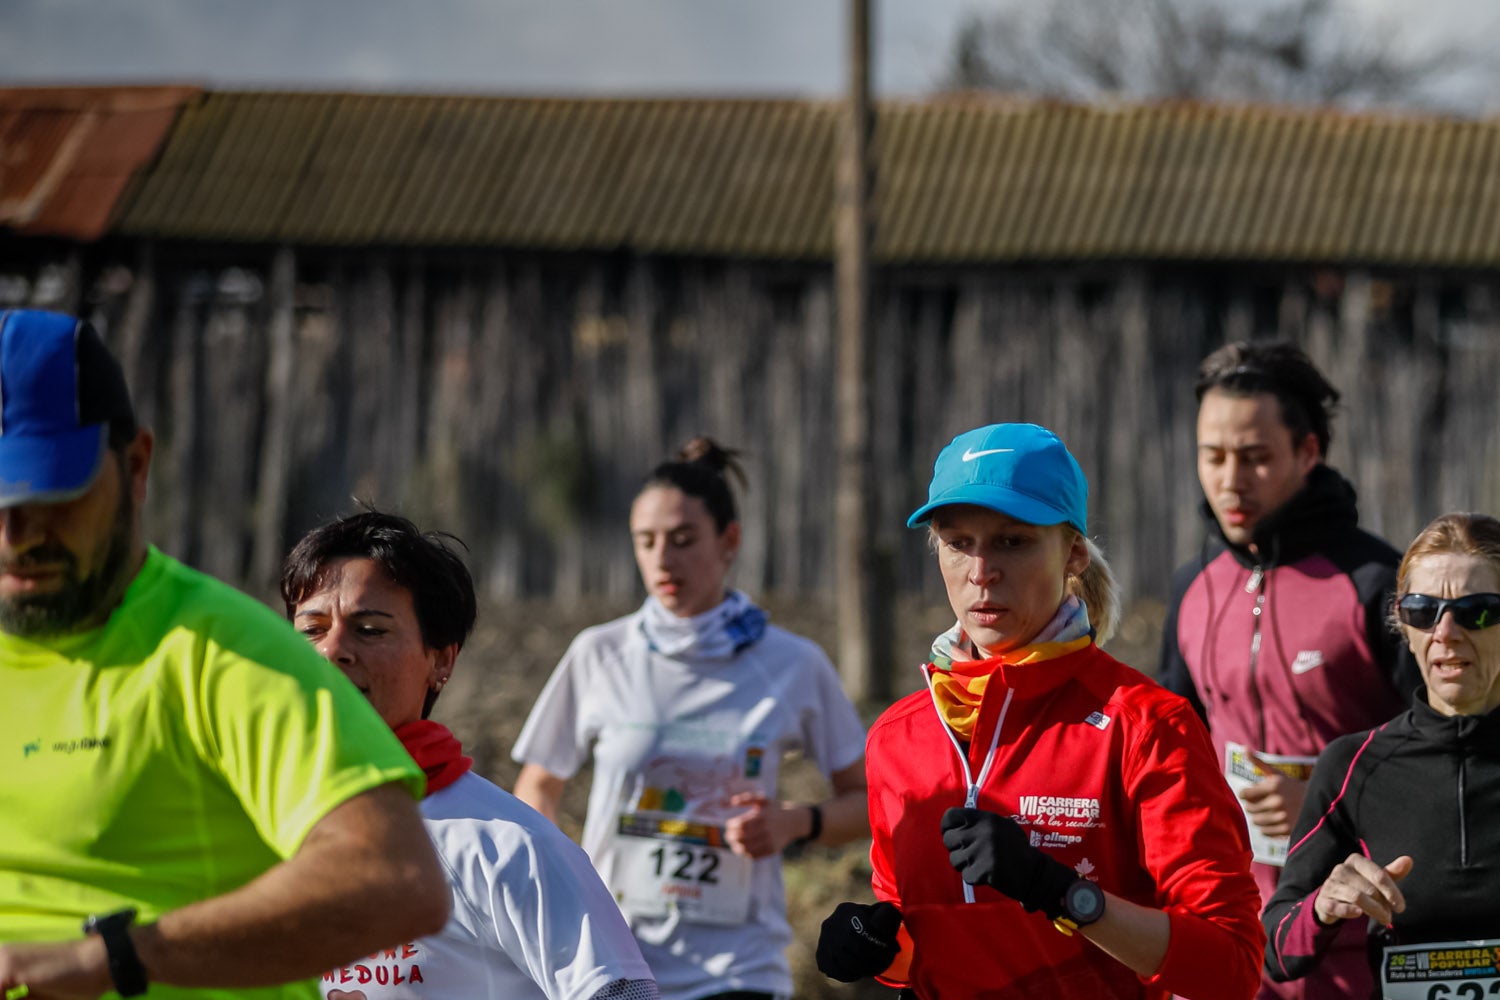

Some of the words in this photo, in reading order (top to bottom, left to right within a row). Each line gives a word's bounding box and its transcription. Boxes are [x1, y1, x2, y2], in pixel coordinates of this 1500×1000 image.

[1019, 796, 1038, 816] VII
[1038, 796, 1100, 809] CARRERA
[1037, 806, 1100, 819] POPULAR
[1033, 815, 1046, 826] de
[1048, 815, 1063, 827] los
[1043, 831, 1082, 844] olimpo
[651, 846, 720, 884] 122
[1429, 949, 1491, 961] CARRERA
[1429, 958, 1491, 970] POPULAR
